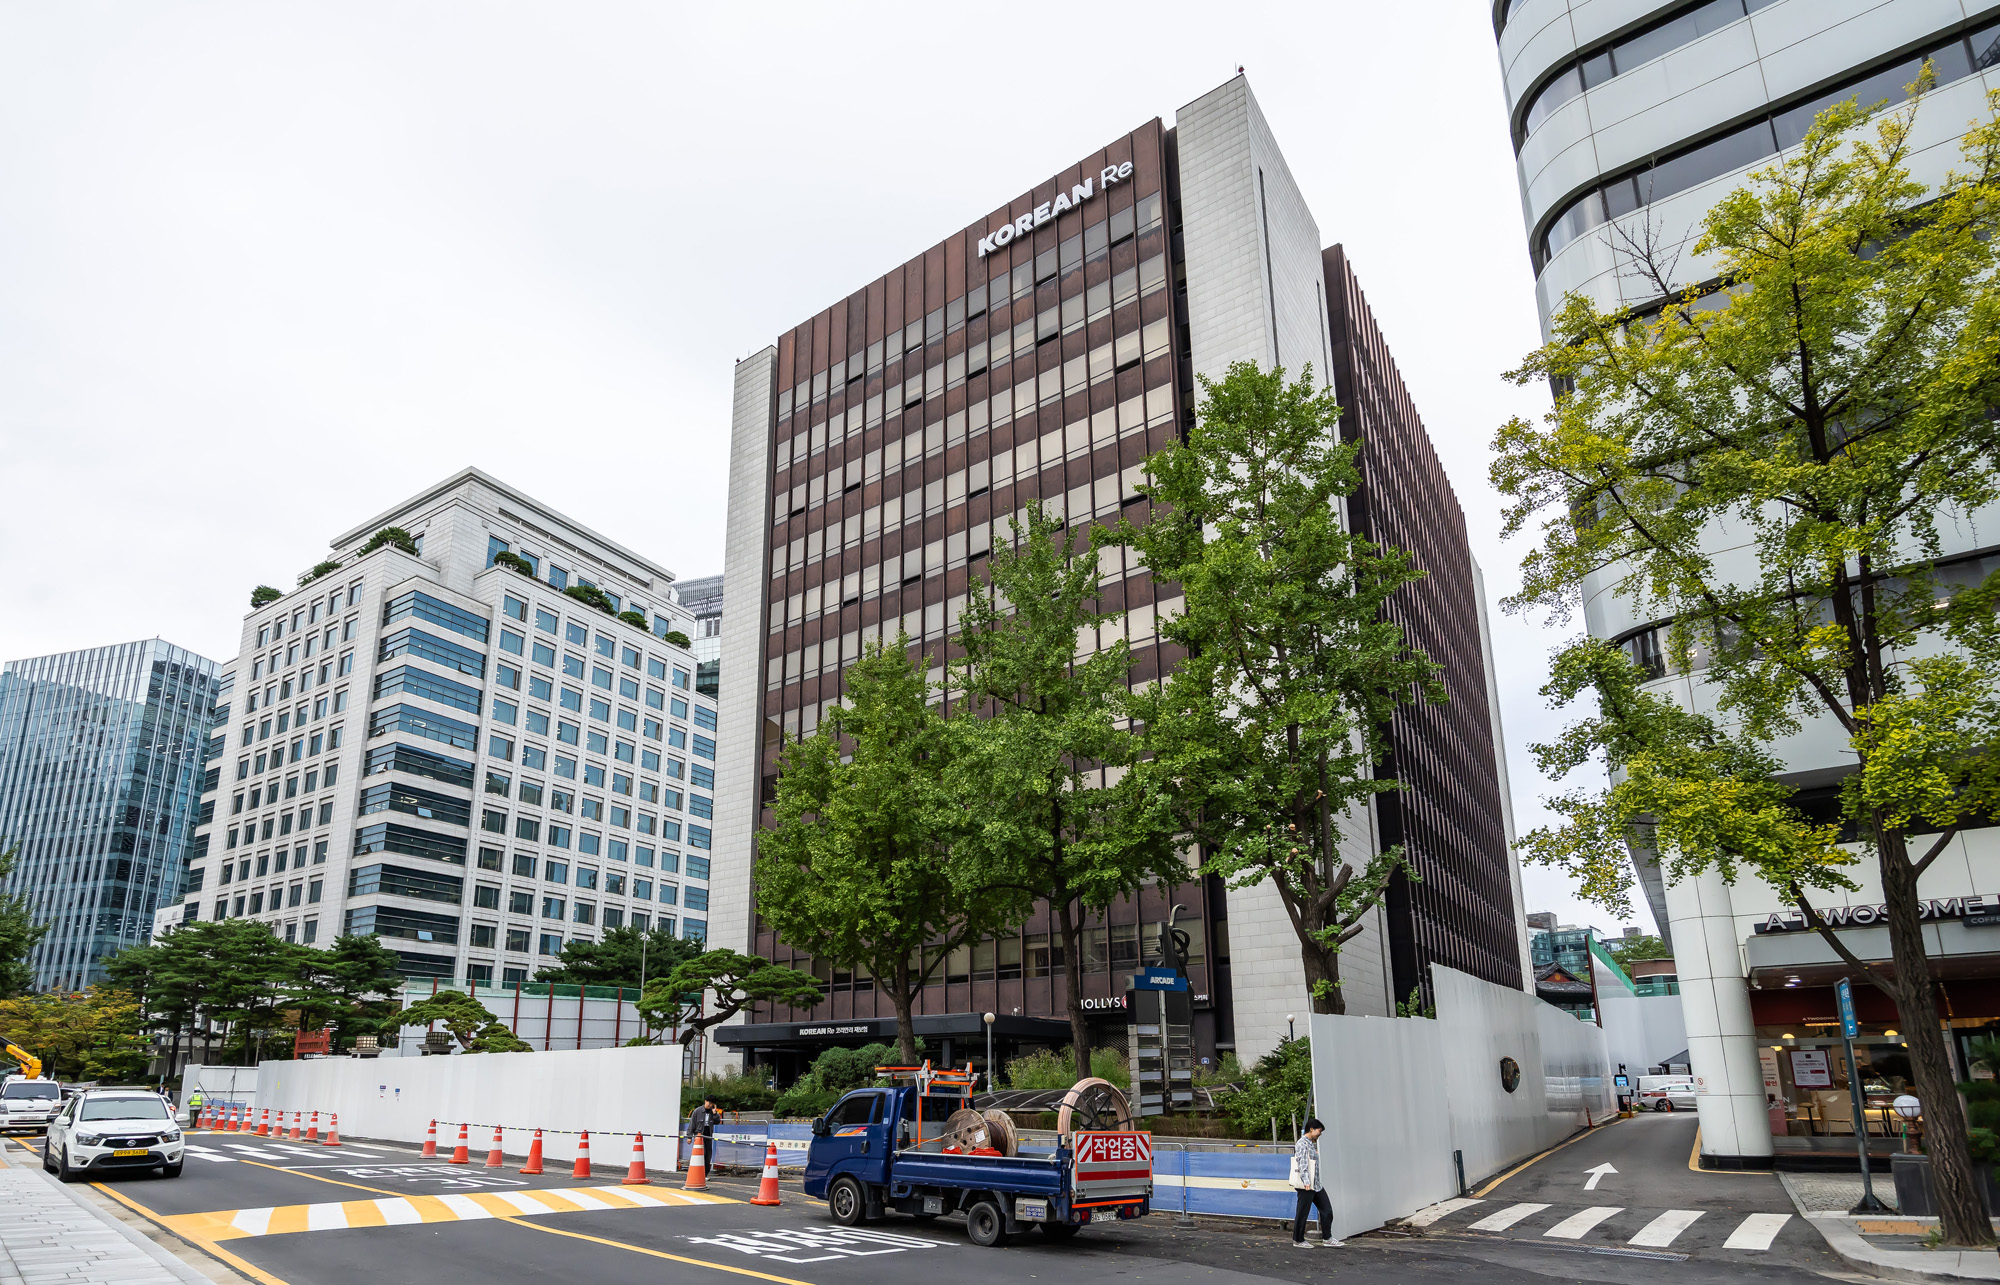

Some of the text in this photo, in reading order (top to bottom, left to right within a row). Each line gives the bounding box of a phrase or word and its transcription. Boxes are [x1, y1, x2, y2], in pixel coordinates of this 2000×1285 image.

[978, 161, 1134, 257] KOREAN Re
[1765, 913, 1788, 931] A
[1149, 976, 1175, 985] ARCADE
[799, 1027, 827, 1036] KOREAN
[826, 1027, 835, 1035] Re
[1093, 1137, 1136, 1160] 작업중
[406, 1176, 530, 1189] 30
[688, 1225, 962, 1264] 천천히
